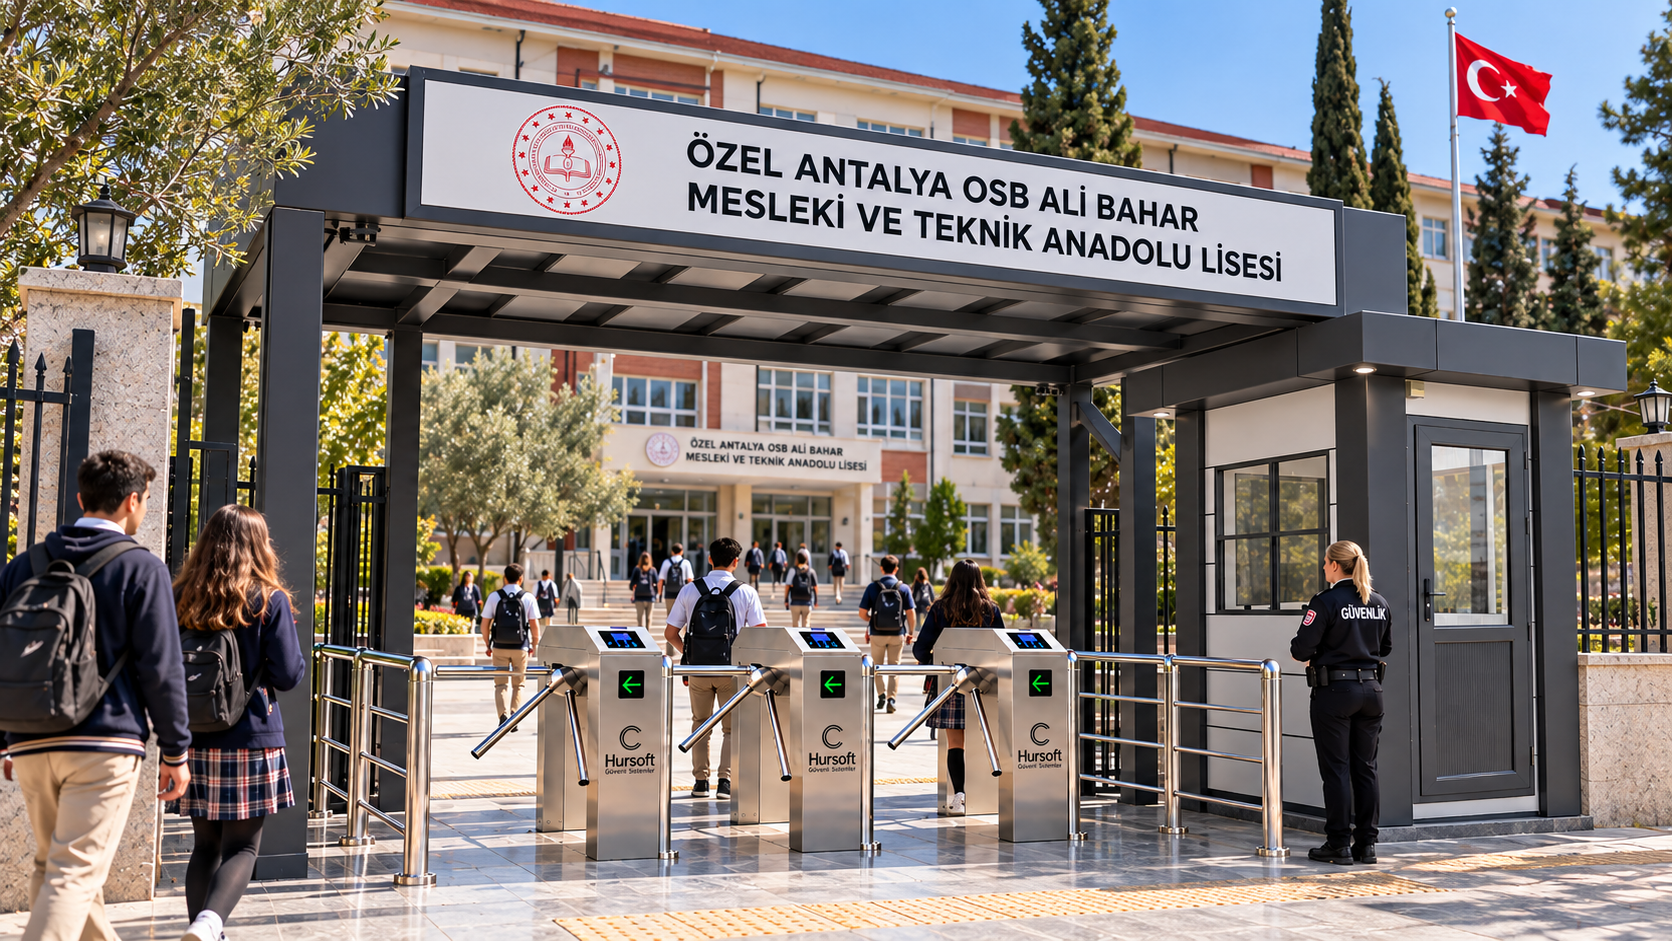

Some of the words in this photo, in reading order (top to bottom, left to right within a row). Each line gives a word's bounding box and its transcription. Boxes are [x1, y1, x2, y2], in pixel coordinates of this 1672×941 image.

[687, 131, 783, 179] ÖZEL
[794, 153, 953, 201] ANTALYA
[963, 175, 1030, 209] OSB
[1039, 185, 1087, 218] ALİ
[1097, 193, 1199, 232] BAHAR
[688, 182, 844, 229] MESLEKİ
[856, 202, 902, 236] VE
[913, 210, 1033, 251] TEKNİK
[1042, 227, 1192, 271] ANADOLU
[1201, 243, 1282, 282] LİSESİ
[690, 436, 716, 449] ÖZEL
[719, 440, 765, 452] ANTALYA
[768, 443, 788, 453] OSB
[791, 443, 807, 454] ALİ
[809, 446, 843, 456] BAHAR
[686, 452, 730, 463] MESLEKİ
[733, 454, 745, 464] VE
[749, 455, 785, 467] TEKNİK
[788, 458, 836, 469] ANADOLU
[838, 459, 867, 472] LİSESİ
[1340, 604, 1387, 621] GÜVENLİK
[605, 752, 656, 767] Hursoft
[808, 751, 856, 766] Hursoft
[1018, 748, 1063, 762] Hursoft
